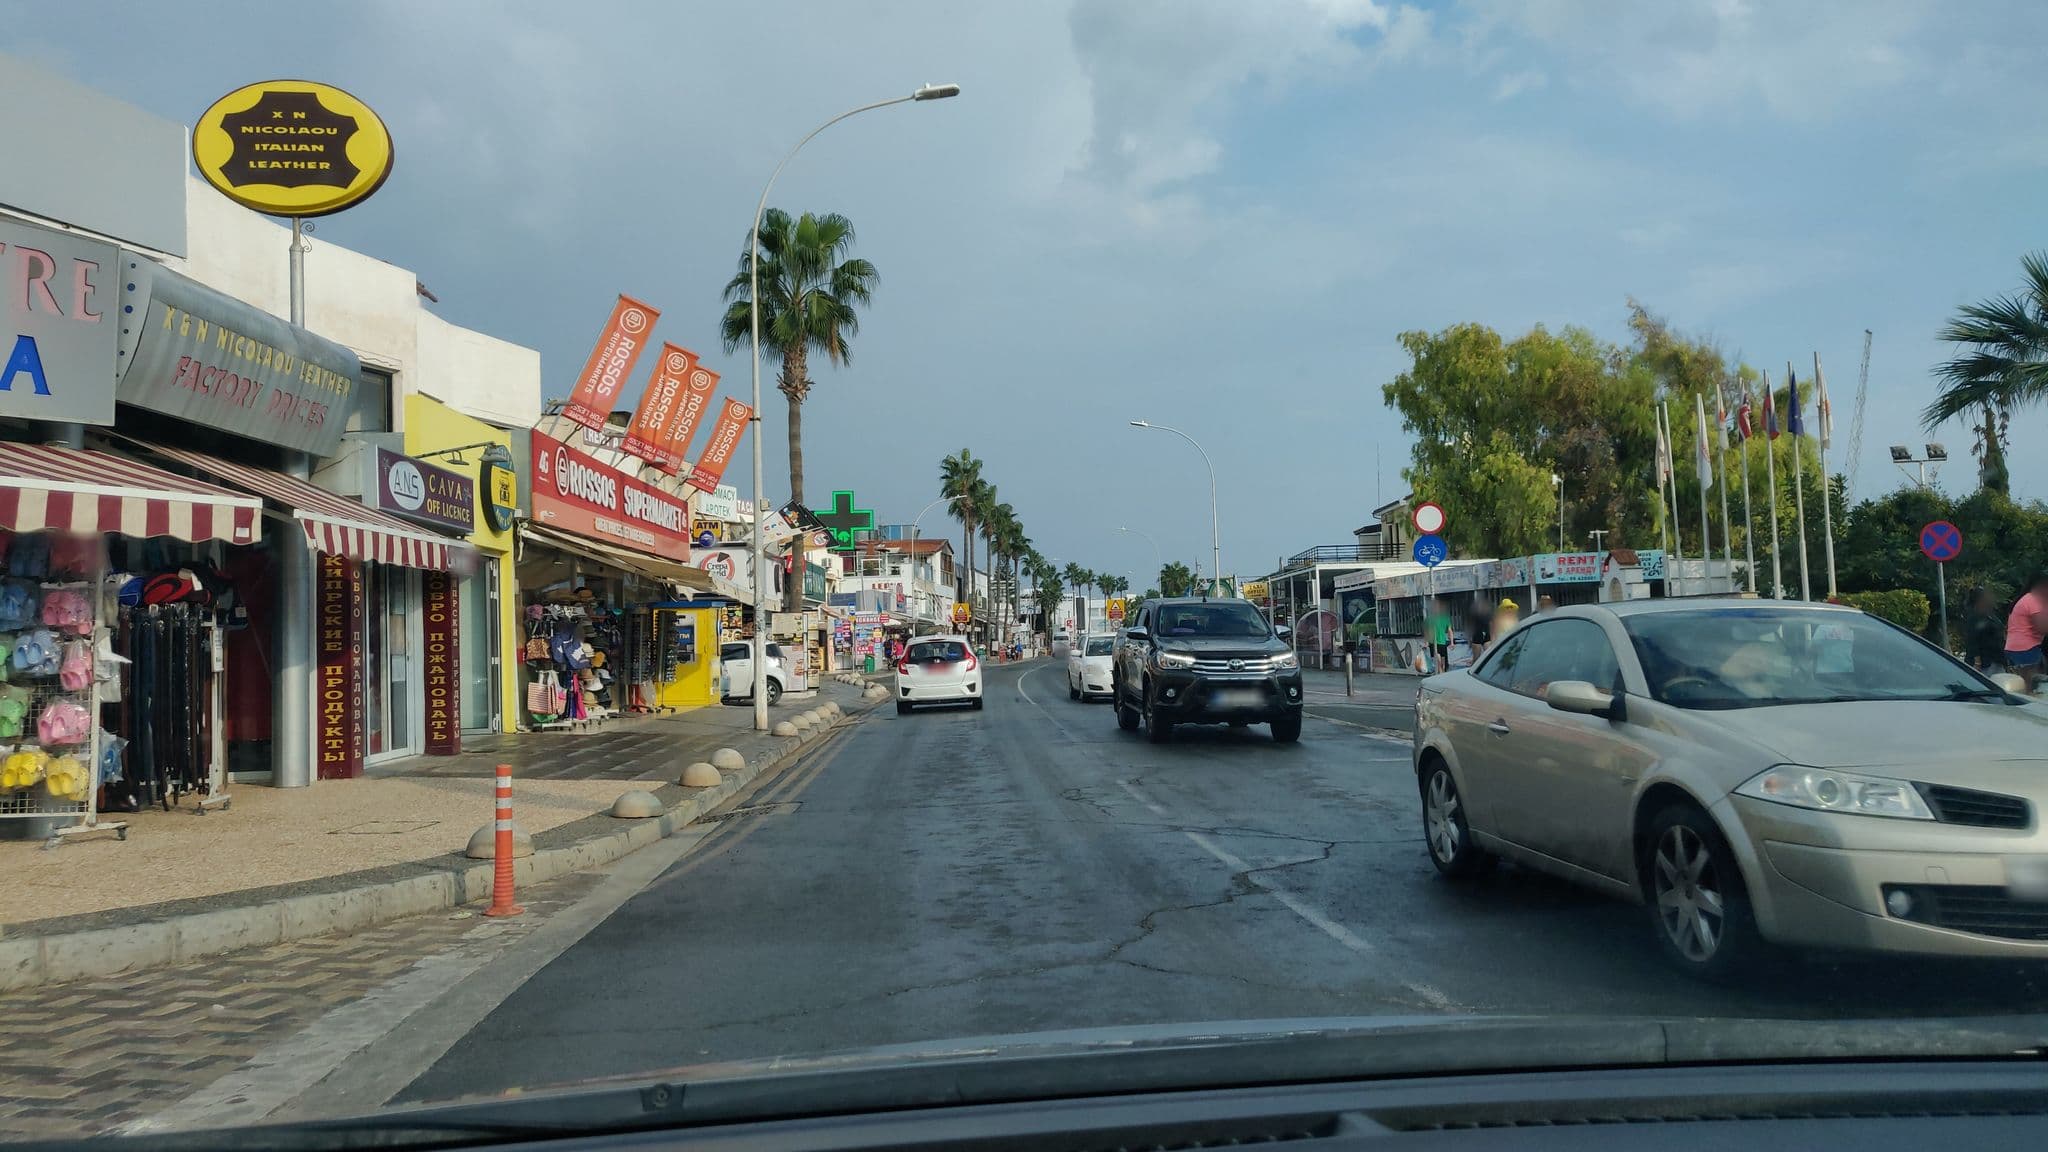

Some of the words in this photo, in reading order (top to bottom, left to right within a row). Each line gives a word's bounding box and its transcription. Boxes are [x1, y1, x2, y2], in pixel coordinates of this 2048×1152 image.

[241, 126, 338, 136] NICOLAOU
[272, 111, 283, 119] X
[293, 111, 306, 119] N
[248, 160, 331, 170] LEATHER
[254, 143, 325, 153] ITALIAN
[0, 241, 104, 324] RE
[162, 305, 178, 331] X
[195, 319, 209, 344] N
[215, 325, 294, 376] NICOLAOU
[298, 359, 353, 399] LEATHER
[584, 331, 621, 394] SUPERMARKETS
[597, 336, 636, 396] ROSSOS
[172, 355, 263, 411] FACTORY
[265, 387, 330, 429] PRICES
[650, 378, 680, 430] ROSSOS
[674, 393, 703, 442] ROSSOS
[712, 422, 740, 464] ROSSOS
[426, 498, 441, 515] OFF
[442, 502, 471, 523] LICENCE
[429, 474, 463, 501] CAVA
[569, 460, 616, 510] ROSSOS
[623, 484, 683, 533] SUPERMARKET
[696, 521, 719, 529] ATM
[1557, 555, 1597, 565] RENT
[324, 556, 344, 652] КИПРСКИЕ
[351, 631, 362, 760] ПОЖАЛОВАТЬ
[428, 632, 447, 741] ПОЖАЛОВАТЬ
[324, 665, 345, 762] ПРОДУКТЫ
